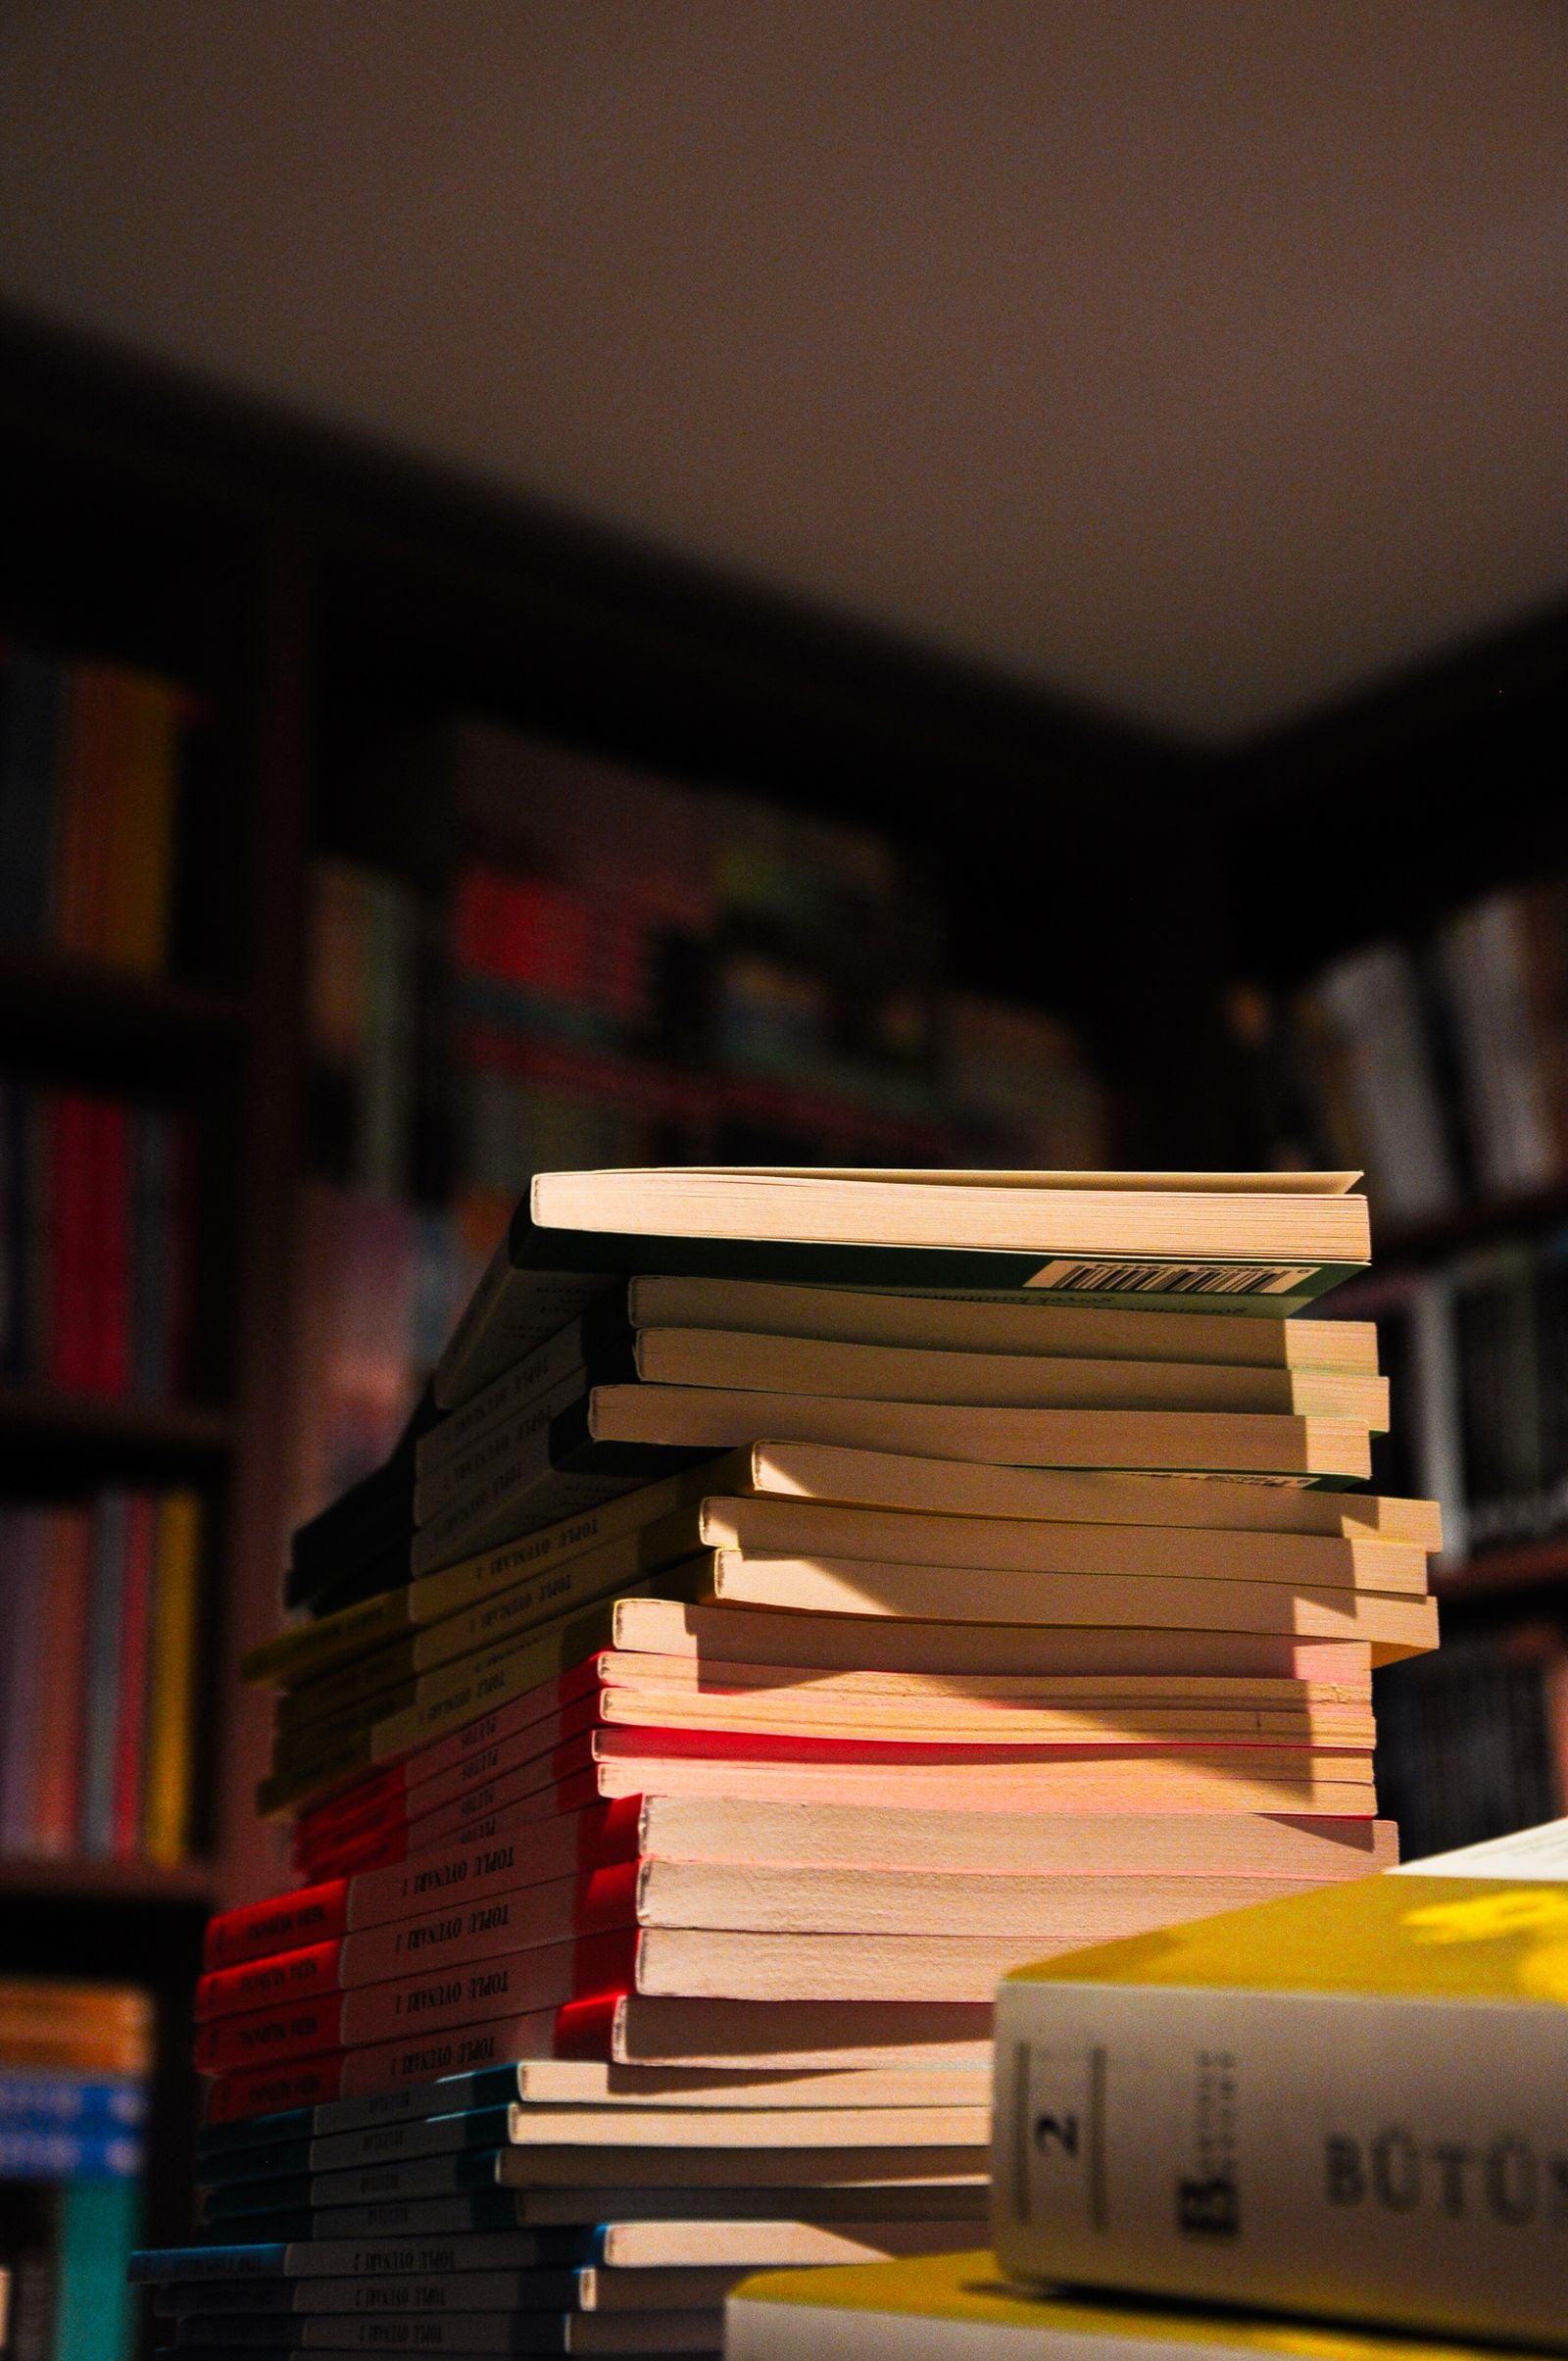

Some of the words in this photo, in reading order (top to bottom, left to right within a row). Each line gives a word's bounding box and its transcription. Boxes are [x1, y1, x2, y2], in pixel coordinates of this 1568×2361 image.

[557, 1518, 601, 1548] TOPLU
[473, 1845, 515, 1877] TOPLU
[468, 1903, 511, 1933] TOPLU
[468, 1969, 511, 1999] TOPLU
[457, 2036, 496, 2068] TOPLU
[1033, 2111, 1080, 2159] 2
[353, 2252, 363, 2273] 2
[419, 2248, 457, 2271] TOPLU
